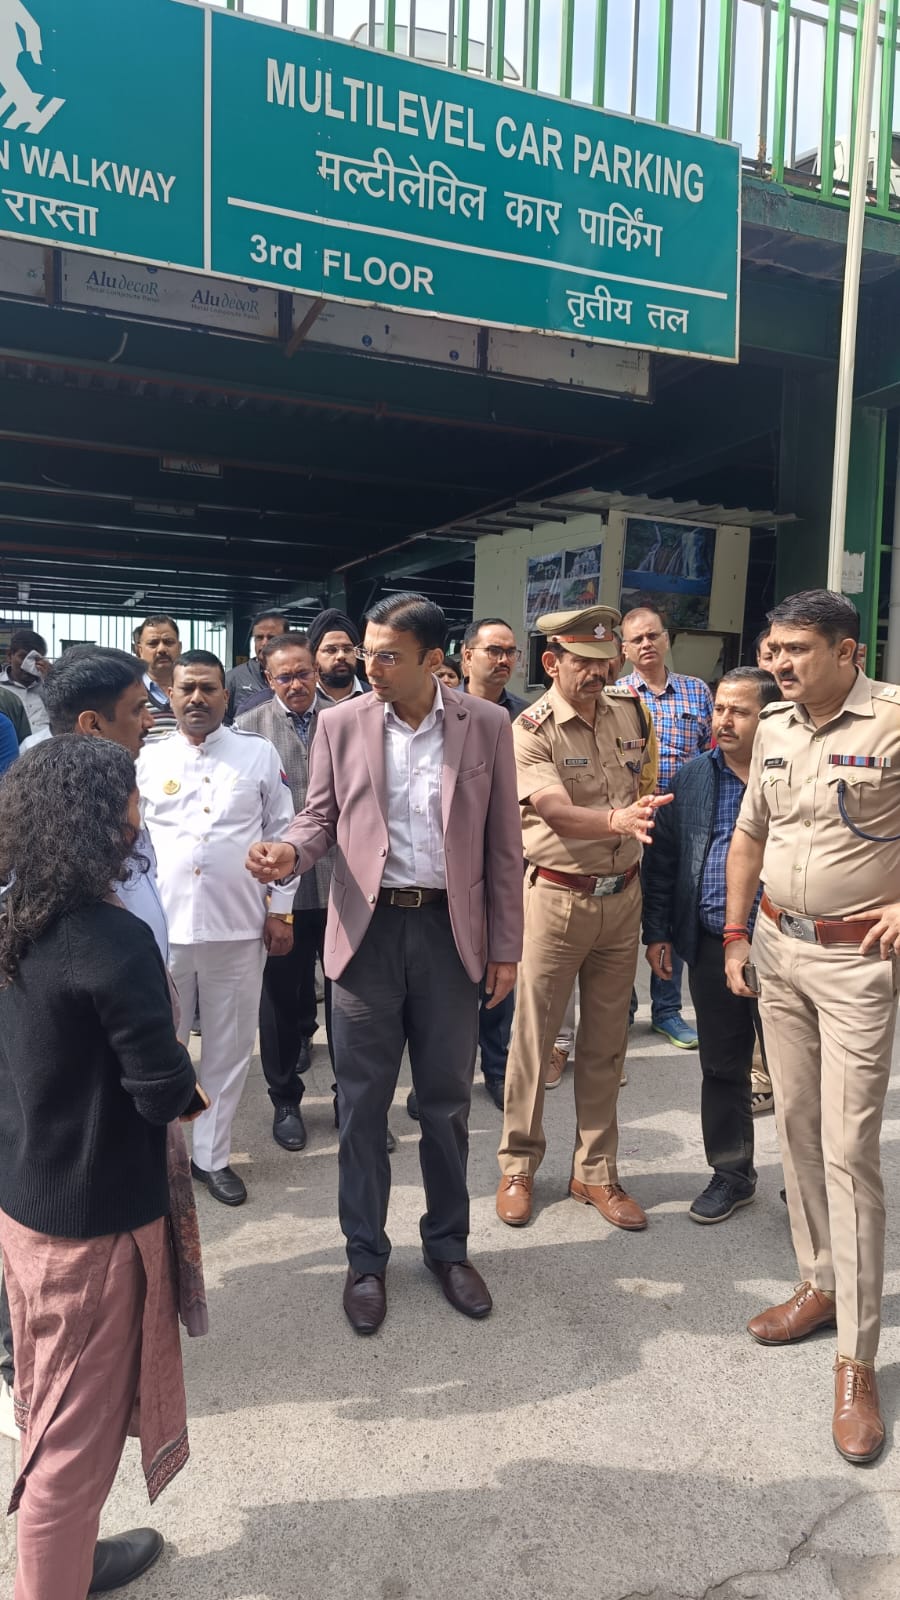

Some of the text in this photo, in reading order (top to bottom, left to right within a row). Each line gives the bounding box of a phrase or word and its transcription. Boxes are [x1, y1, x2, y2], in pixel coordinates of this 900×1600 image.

[266, 57, 705, 204] MULTILEVEL CAR PARKING
[19, 143, 177, 205] WALKWAY
[315, 147, 664, 259] मल्टीलेविल कार पार्किंग
[1, 188, 99, 237] रास्ता
[249, 234, 435, 296] 3rd FLOOR
[565, 284, 690, 336] तृतीय तल
